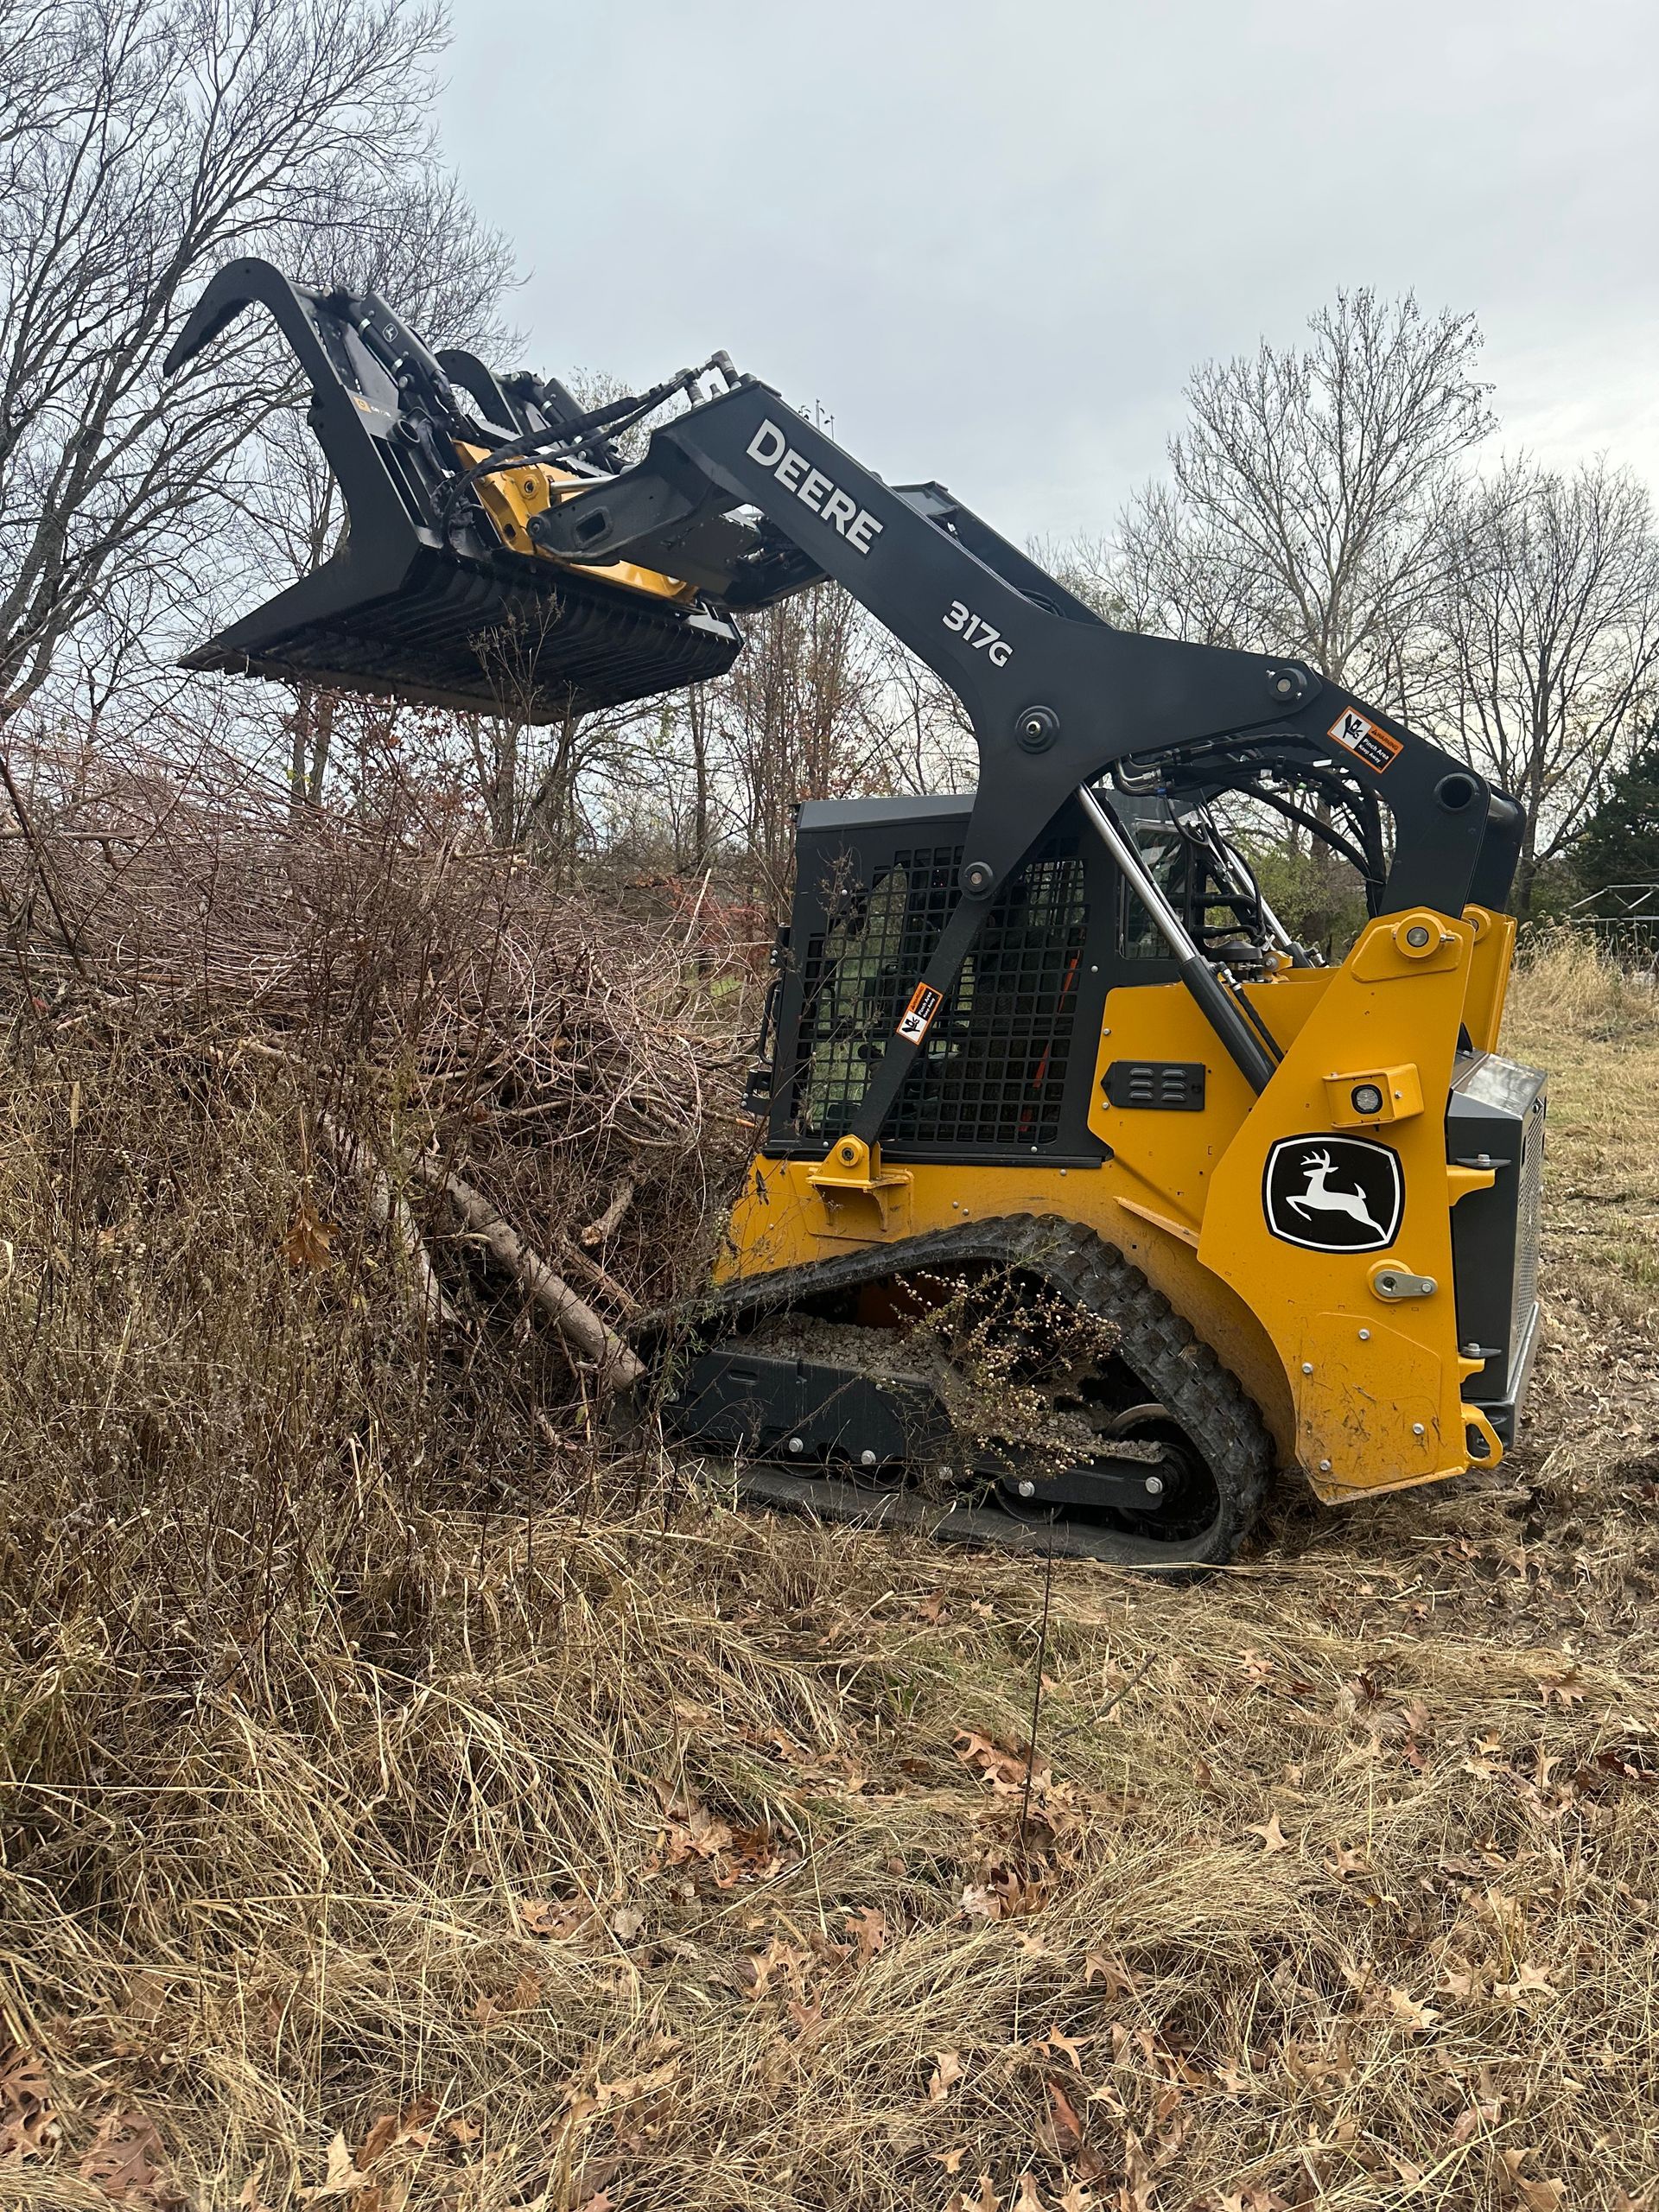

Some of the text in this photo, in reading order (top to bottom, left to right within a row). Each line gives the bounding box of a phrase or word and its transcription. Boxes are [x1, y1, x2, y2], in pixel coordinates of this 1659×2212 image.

[746, 418, 884, 555] DEERE
[942, 600, 1014, 668] 317G
[1363, 738, 1389, 760] Pinch Area
[1376, 731, 1399, 751] WARNING
[1357, 744, 1382, 764] Keep Away
[918, 991, 932, 1015] Pinch Area
